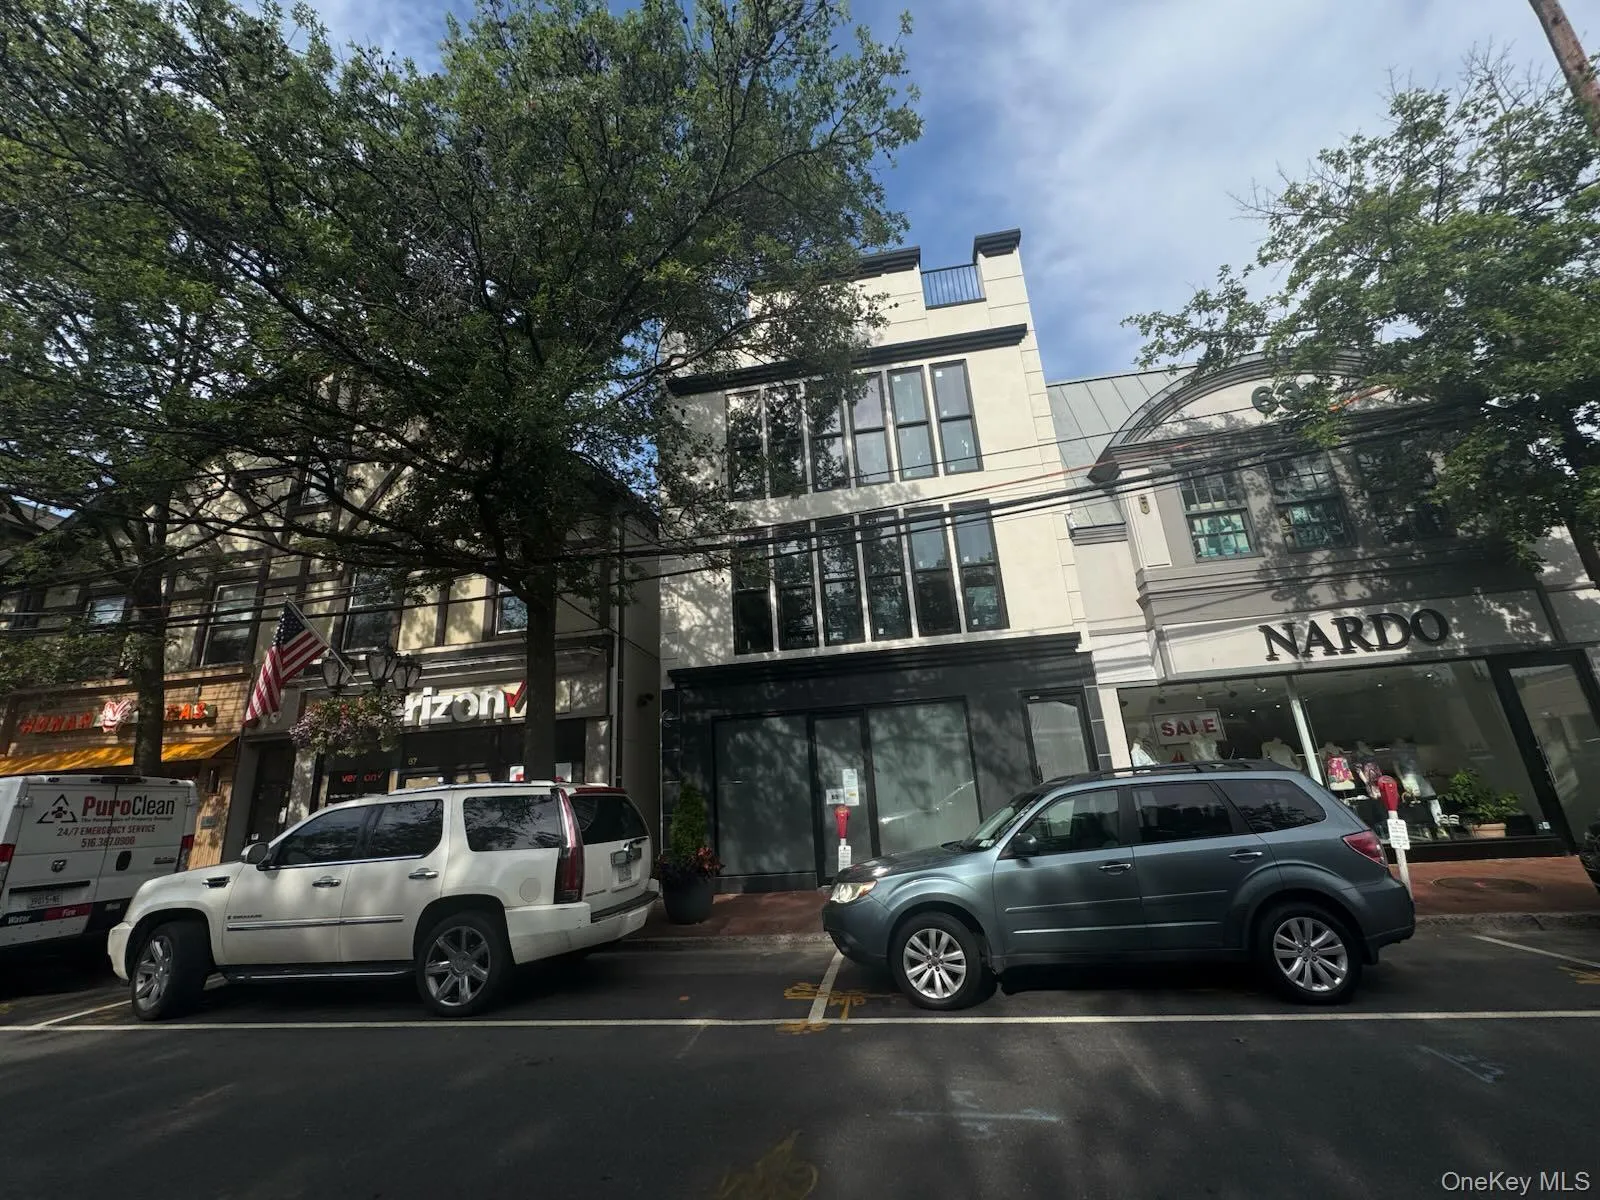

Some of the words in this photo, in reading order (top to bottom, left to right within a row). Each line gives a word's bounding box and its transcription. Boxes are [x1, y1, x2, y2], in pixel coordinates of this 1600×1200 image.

[1258, 608, 1449, 662] NARDO
[402, 686, 507, 726] rizon
[1161, 718, 1217, 737] SALE
[82, 795, 175, 817] PuroClean
[57, 827, 79, 837] 24/7
[80, 825, 126, 836] EMERGENCY
[127, 824, 156, 834] SERVICE
[62, 908, 77, 918] Fire
